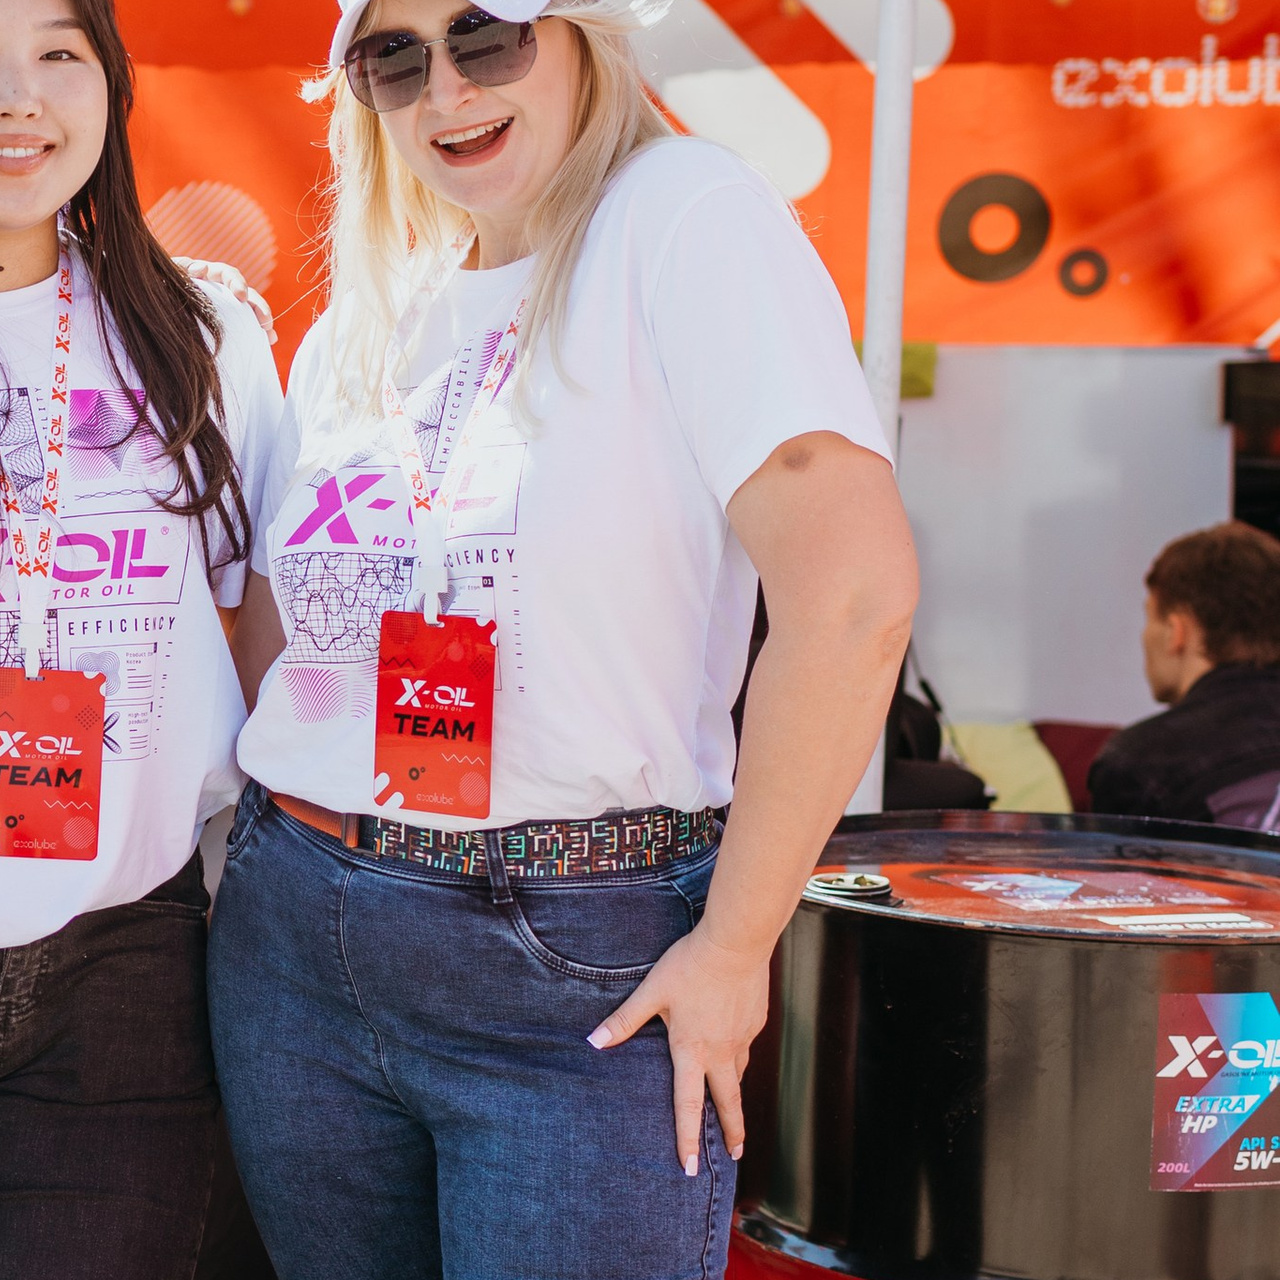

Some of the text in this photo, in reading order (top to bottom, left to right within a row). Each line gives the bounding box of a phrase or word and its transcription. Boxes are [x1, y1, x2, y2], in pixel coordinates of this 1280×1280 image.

[55, 313, 71, 354] X-OIL
[52, 363, 67, 405] X-OIL
[48, 414, 64, 457] X-OIL
[42, 467, 58, 515] X-OIL
[410, 469, 432, 512] X-OIL
[13, 527, 32, 578] X-OIL
[32, 527, 51, 578] X-OIL
[443, 549, 516, 569] CIENCY
[101, 583, 135, 597] OIL
[68, 616, 176, 636] EFFICIENCY
[394, 678, 476, 708] X-OIL
[424, 703, 449, 711] MOTOR
[393, 713, 476, 742] TEAM
[13, 838, 57, 850] exolube
[1175, 1096, 1246, 1113] EXTRA
[1181, 1115, 1218, 1134] HP
[1239, 1136, 1266, 1151] API
[1157, 1162, 1190, 1174] 200L
[1234, 1150, 1280, 1171] 5W-
